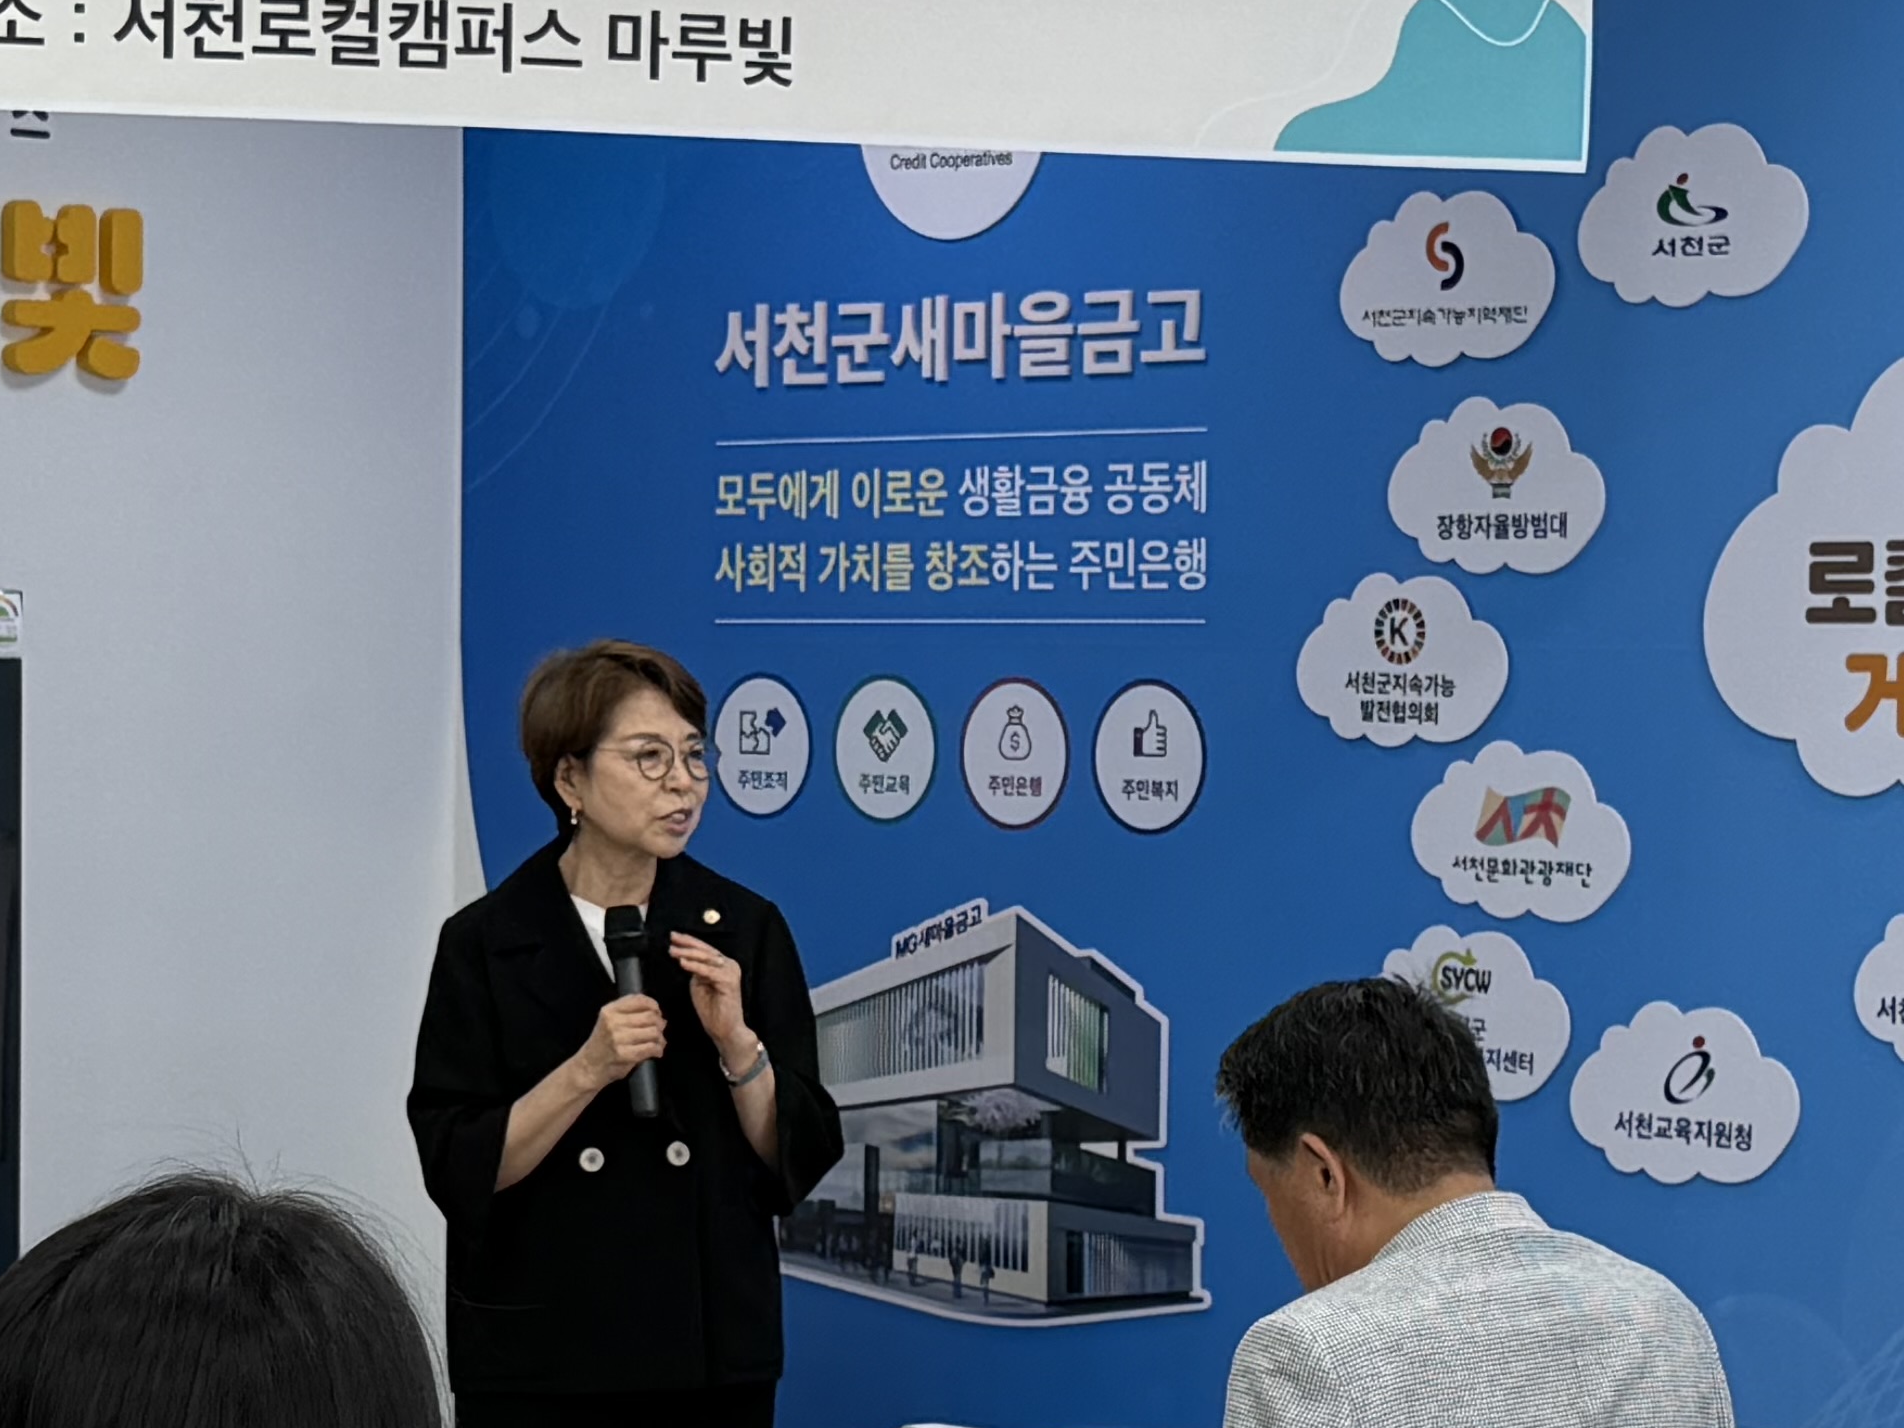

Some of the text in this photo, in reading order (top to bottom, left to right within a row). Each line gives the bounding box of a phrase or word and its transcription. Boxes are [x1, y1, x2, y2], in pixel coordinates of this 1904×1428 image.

[607, 9, 793, 88] 마루빛
[888, 150, 1014, 174] Credit Cooperatives
[1651, 234, 1731, 258] 서천군
[714, 289, 1207, 390] 서천군새마을금고
[715, 459, 1207, 521] 모두에게 이로운 생활금융 공동체
[1436, 511, 1568, 541] 장항자율방범대
[714, 536, 1207, 593] 사회적 가치를 창조하는 주민은행
[1344, 670, 1457, 699] 서천군지속가능
[1359, 698, 1439, 726] 발전협의회
[858, 772, 911, 796] 주민교육
[987, 774, 1043, 798] 주민은행
[1121, 778, 1179, 802] 주민복지
[1451, 855, 1593, 889] 서천문화관광재단
[1439, 965, 1493, 995] SYCW
[1485, 1046, 1535, 1076] 지센터
[1614, 1110, 1753, 1152] 서천교육지원청
